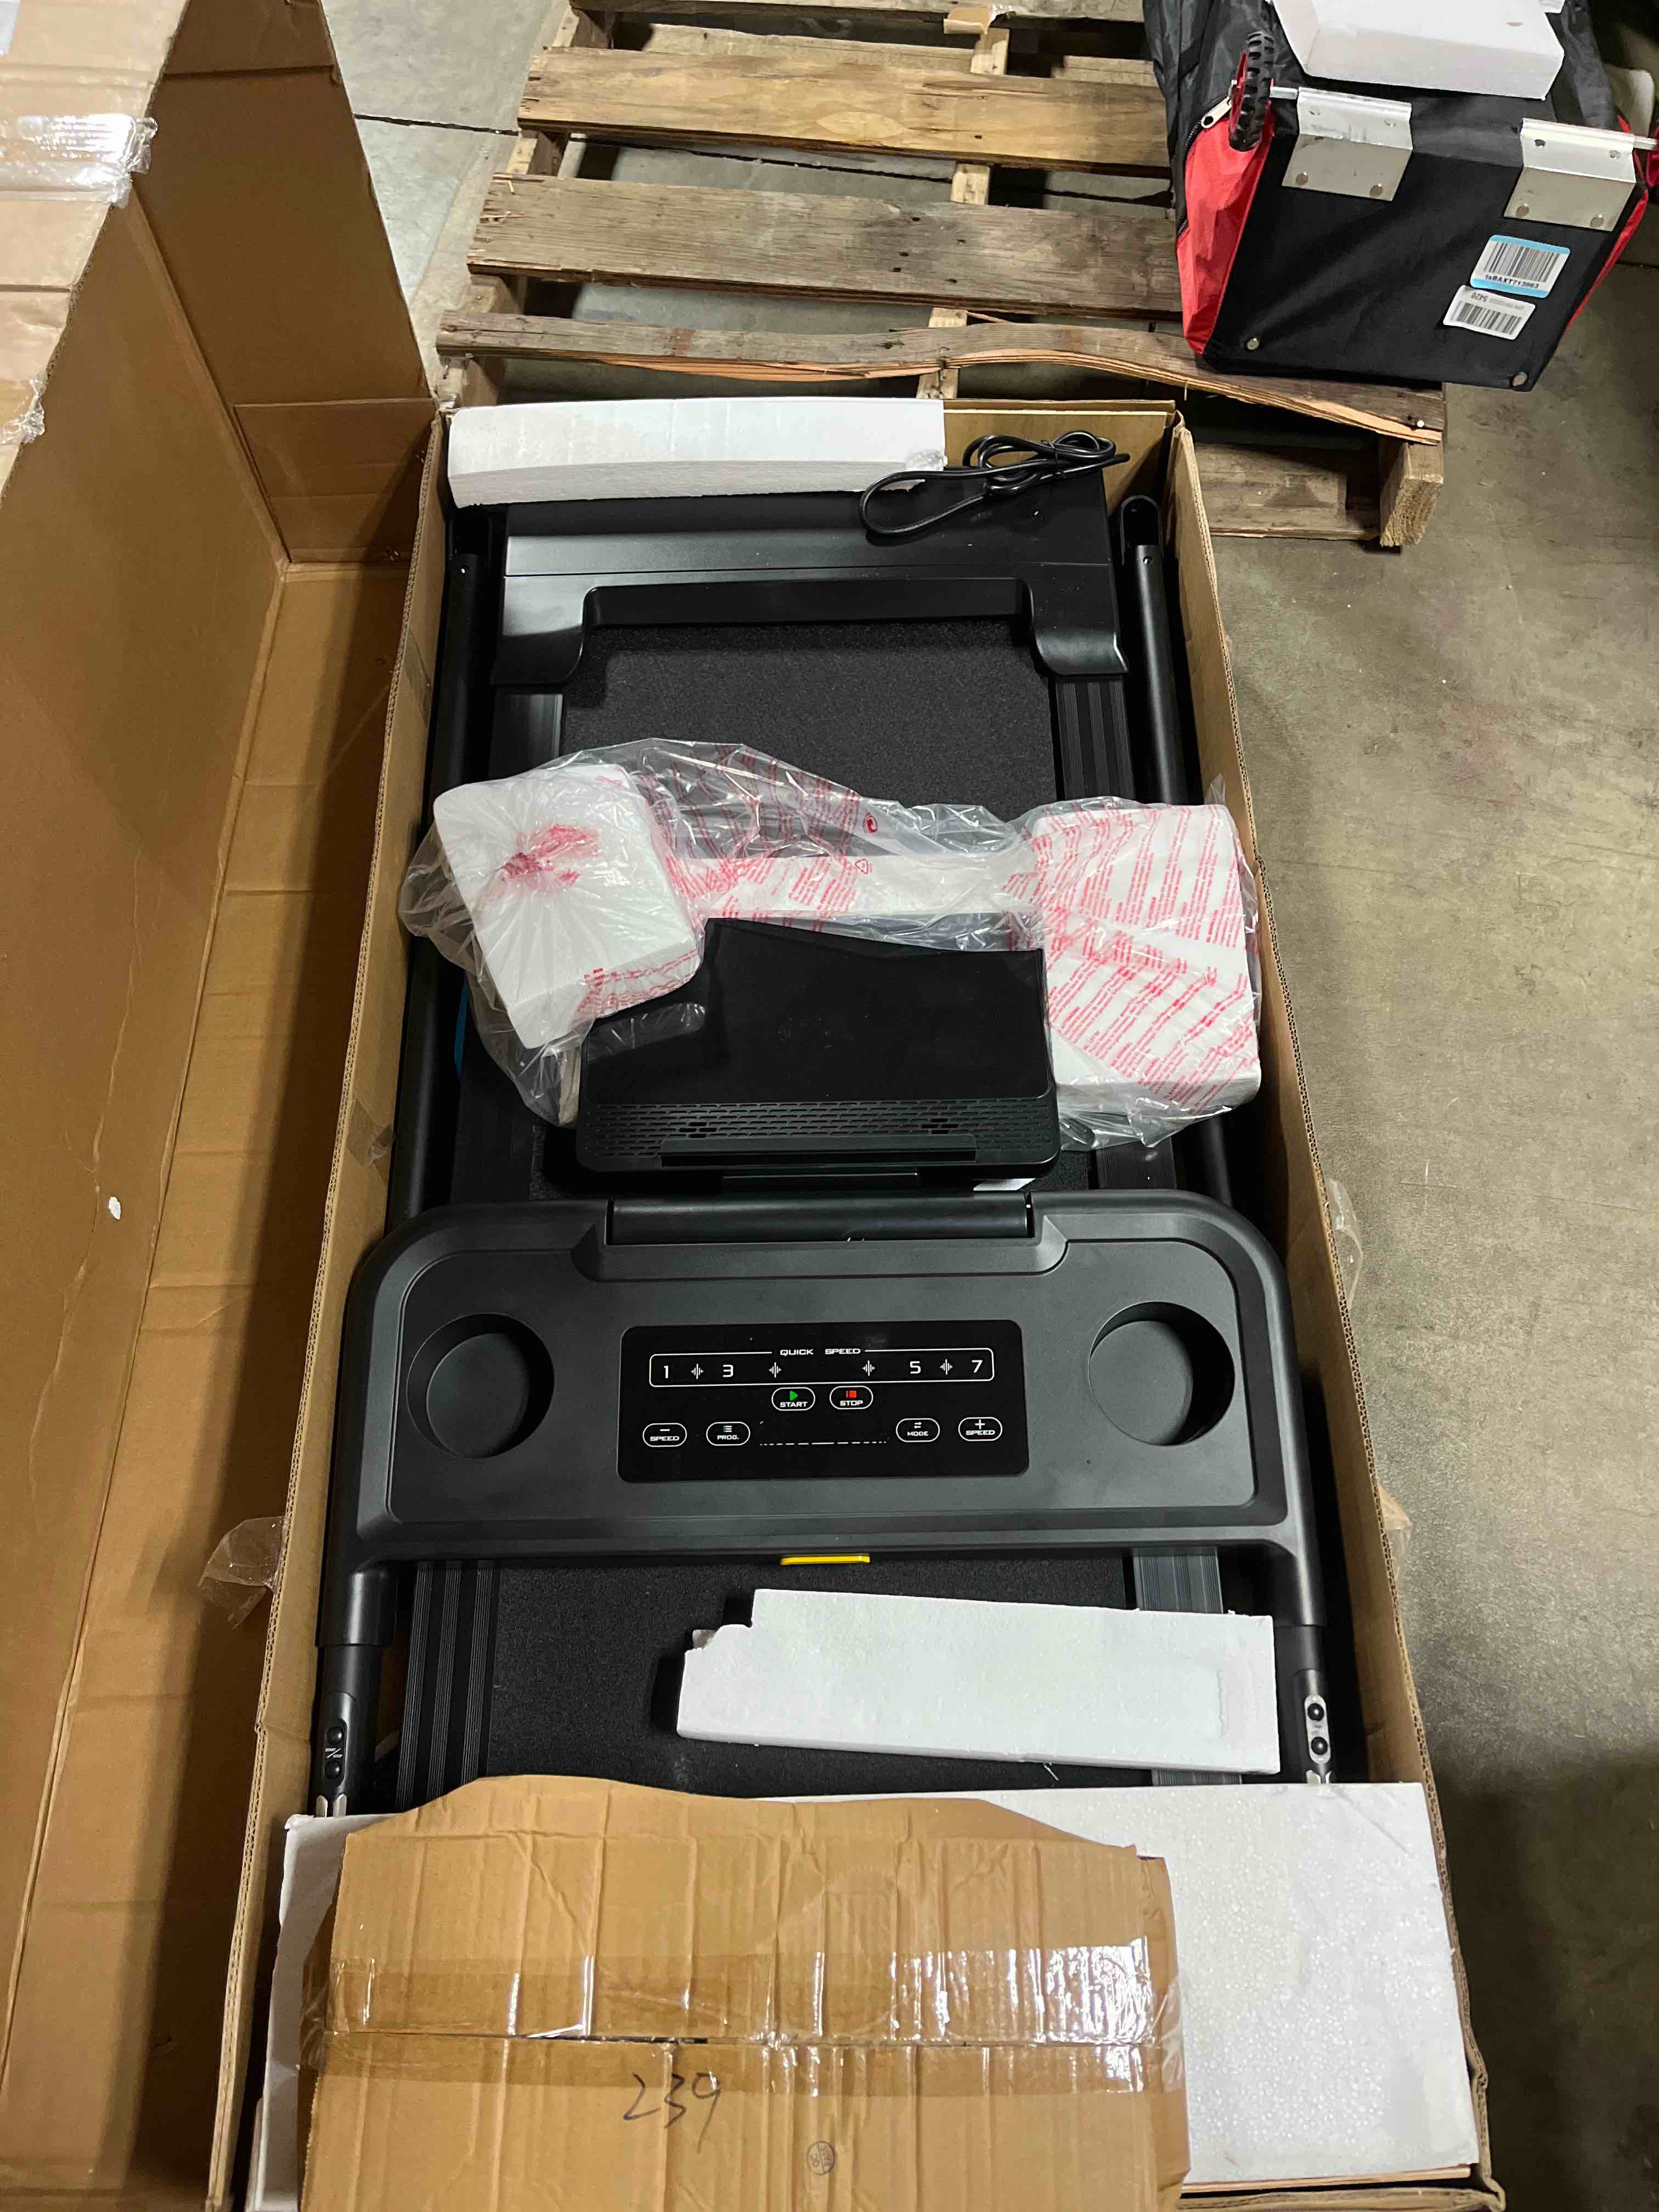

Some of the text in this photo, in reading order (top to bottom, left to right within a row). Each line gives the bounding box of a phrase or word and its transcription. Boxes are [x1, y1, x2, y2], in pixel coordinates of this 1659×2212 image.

[780, 1347, 861, 1357] QUICK SPEED
[663, 1359, 983, 1379] 1 3 5 7
[623, 2072, 722, 2153] 239
